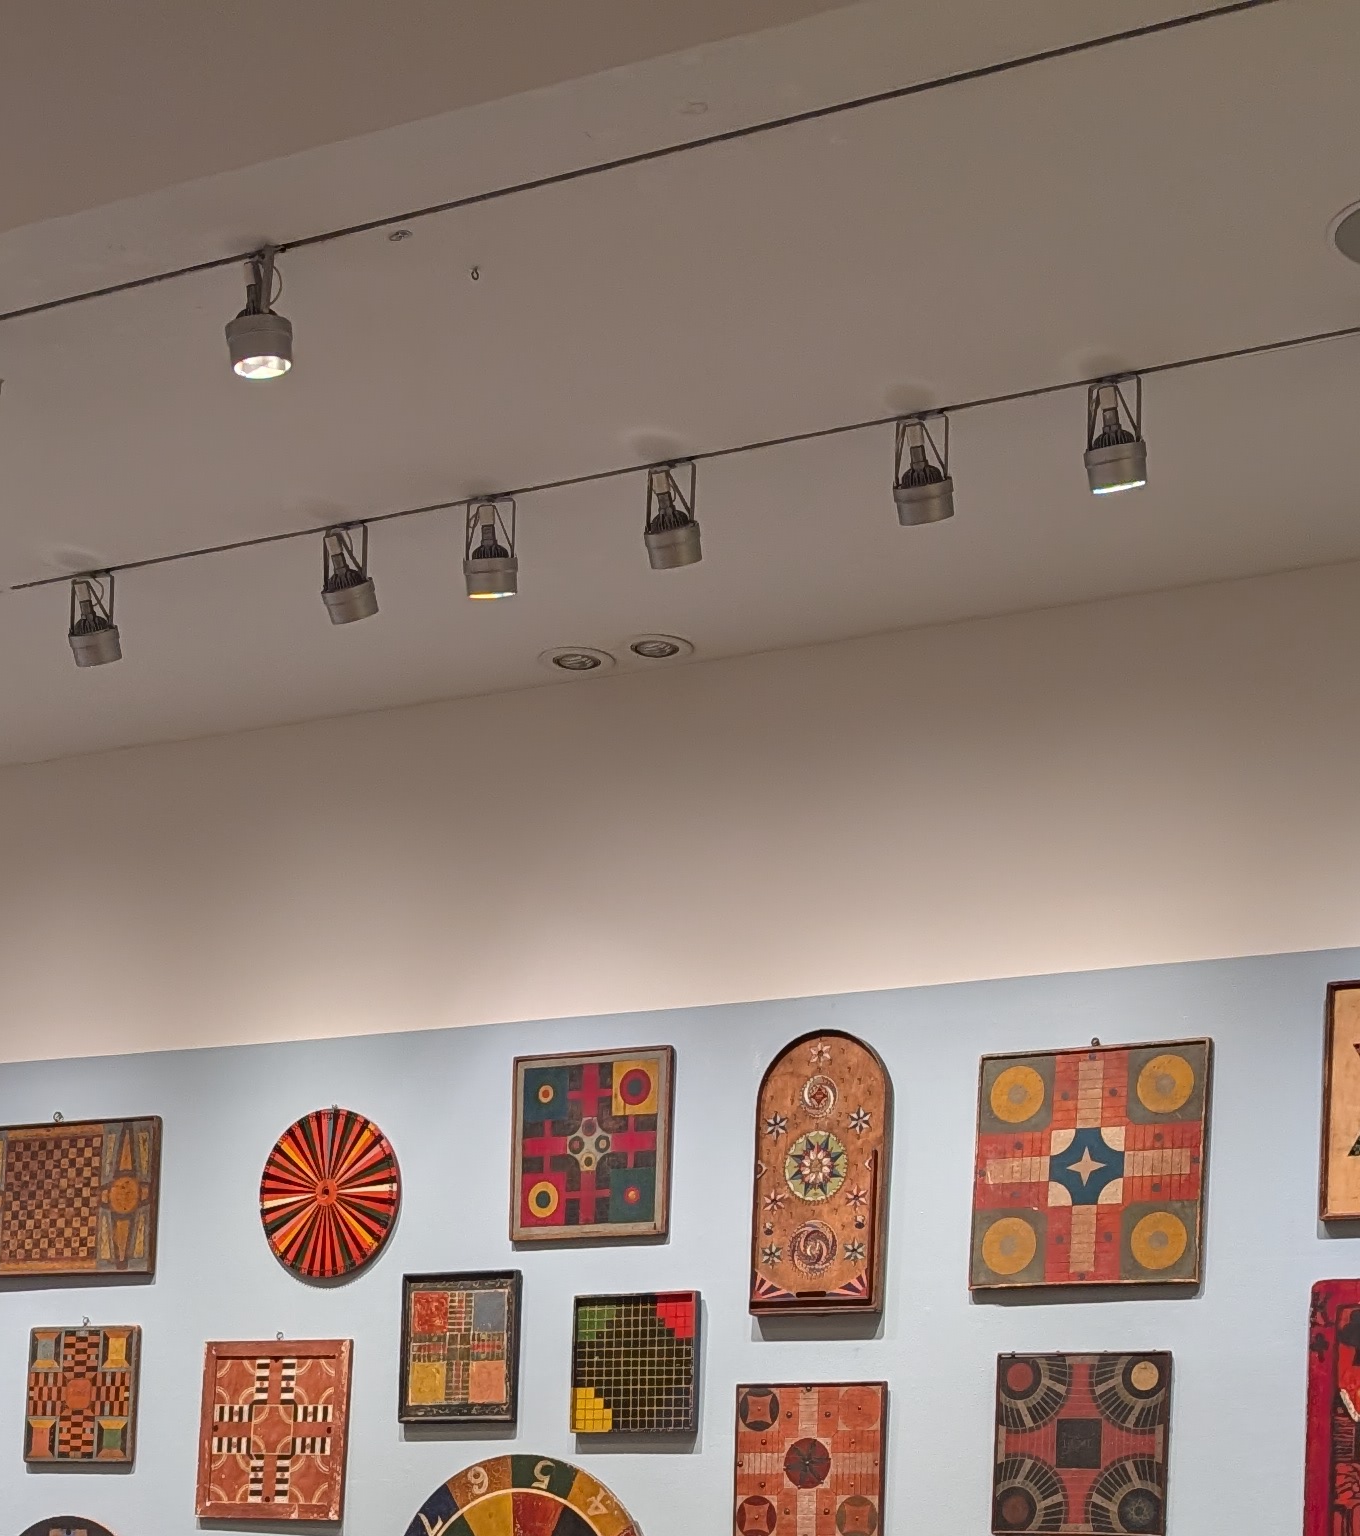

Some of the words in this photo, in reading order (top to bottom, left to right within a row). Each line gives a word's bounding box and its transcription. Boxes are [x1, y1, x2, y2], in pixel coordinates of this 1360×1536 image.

[467, 1466, 489, 1494] 6
[531, 1459, 556, 1490] 5
[587, 1491, 609, 1516] 4
